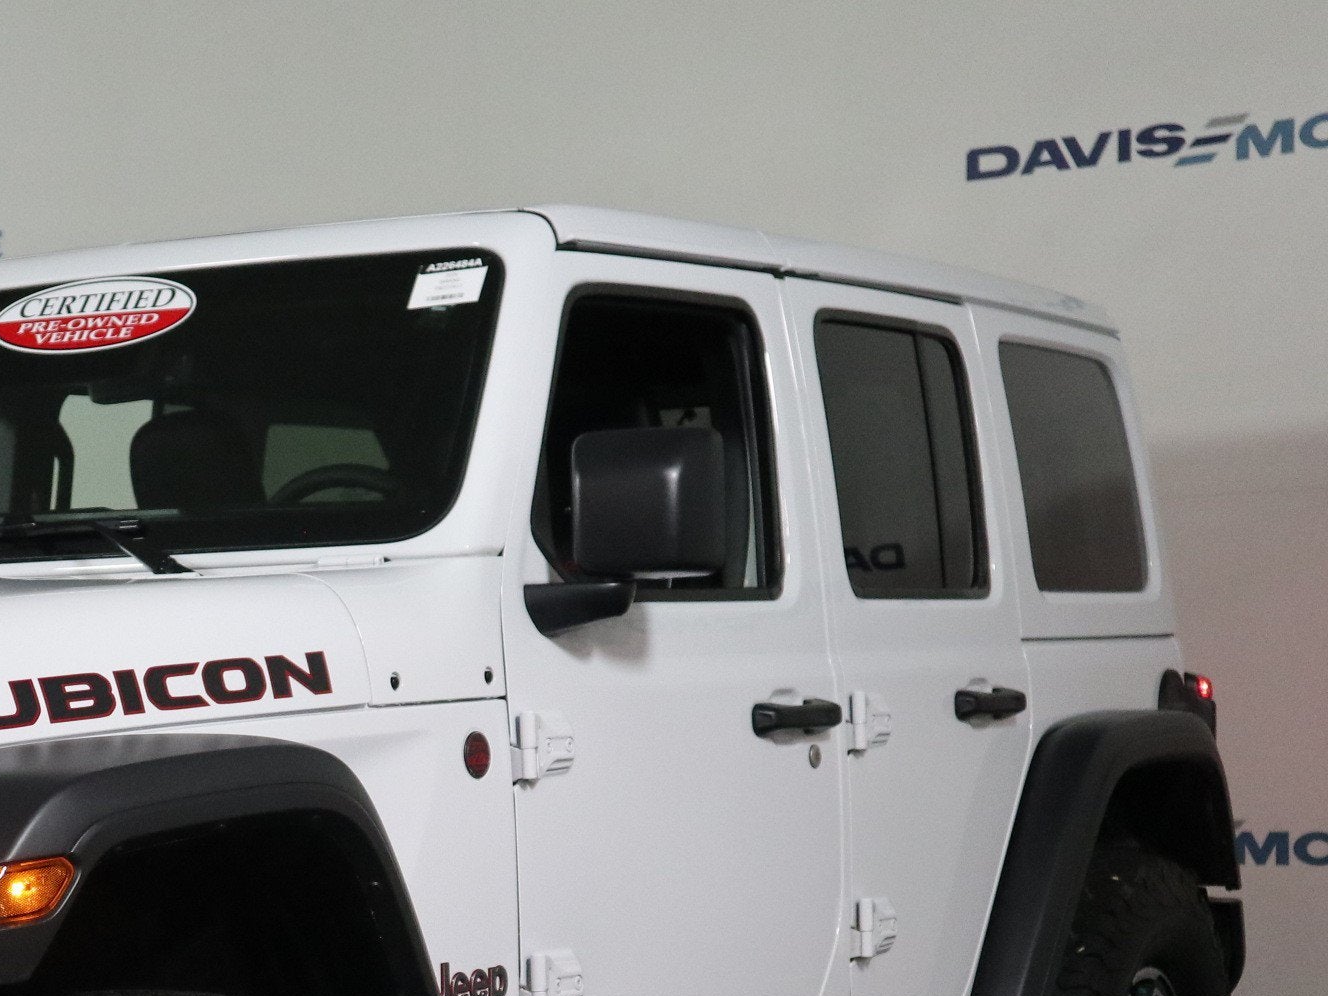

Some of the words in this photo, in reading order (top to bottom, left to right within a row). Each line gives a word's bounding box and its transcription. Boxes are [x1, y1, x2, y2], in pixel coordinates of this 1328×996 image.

[966, 122, 1187, 182] DAVIS
[20, 287, 177, 319] CERTIFIED
[16, 312, 160, 335] PRE-OWNED
[34, 326, 135, 346] VEHICLE
